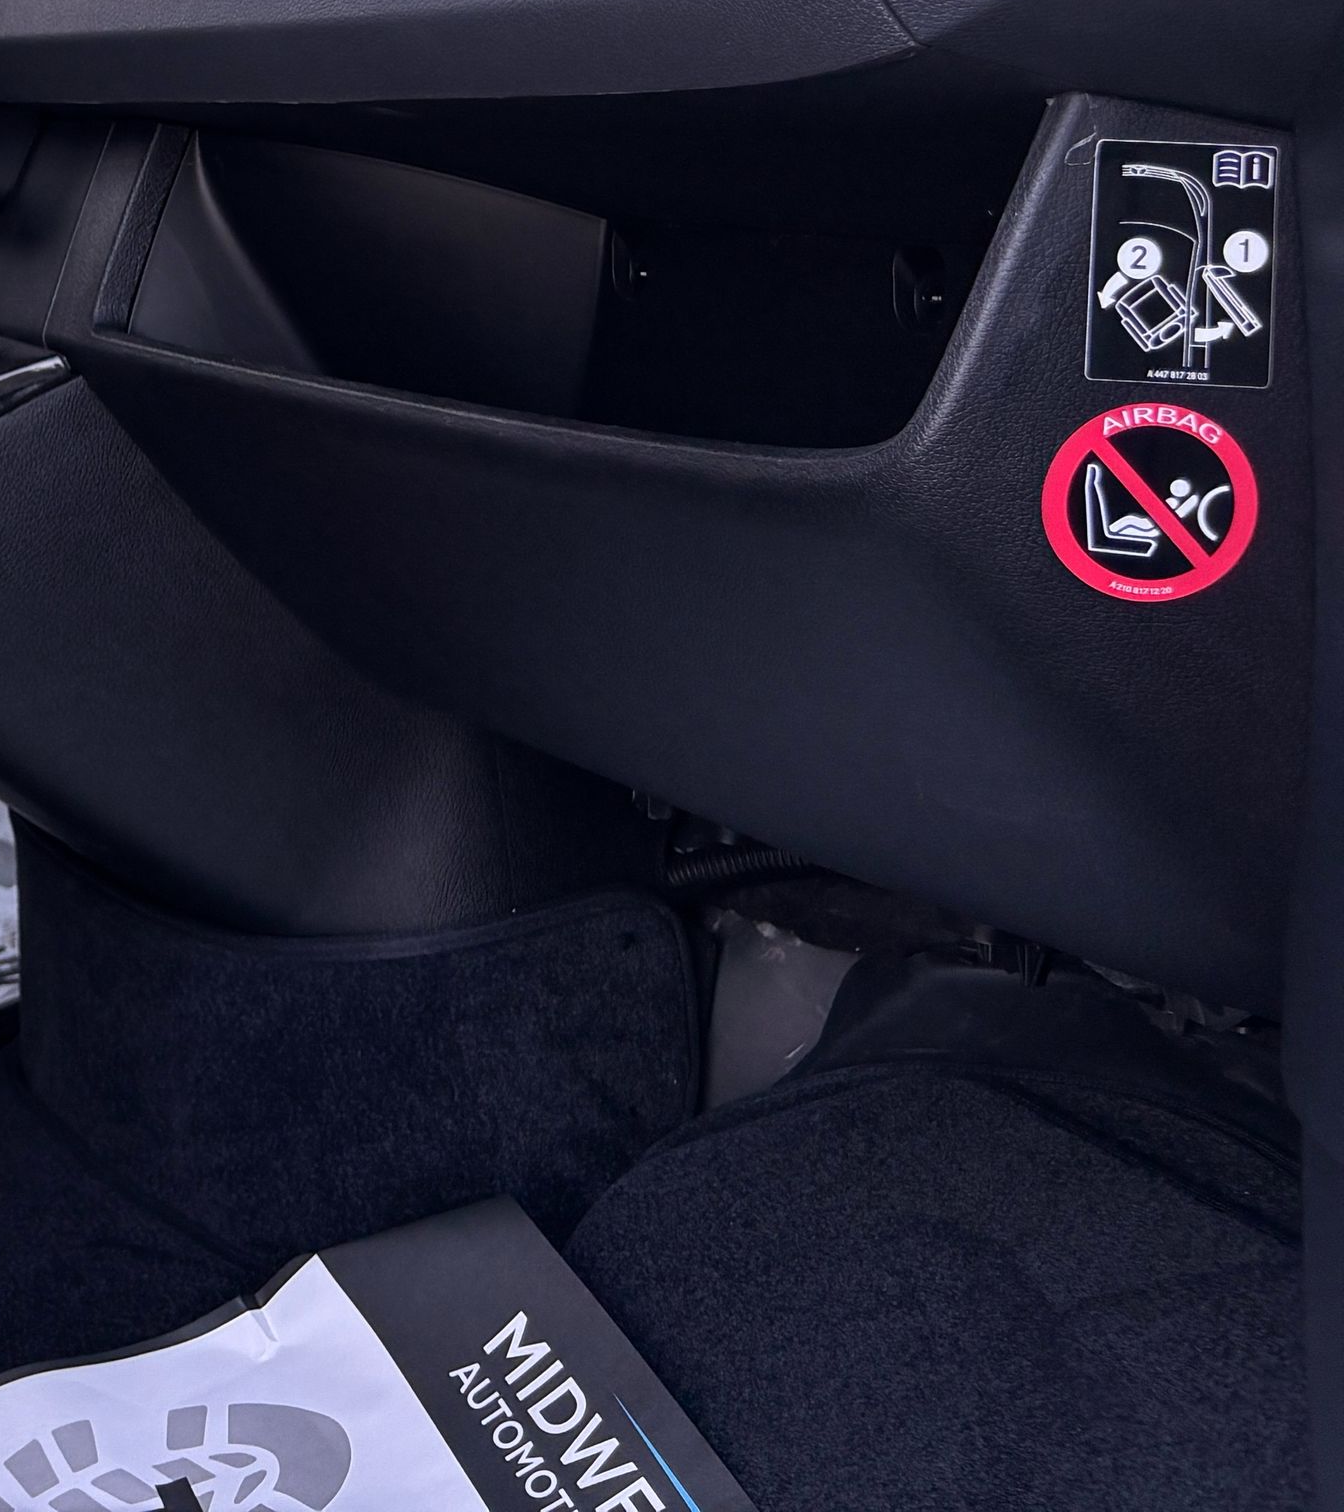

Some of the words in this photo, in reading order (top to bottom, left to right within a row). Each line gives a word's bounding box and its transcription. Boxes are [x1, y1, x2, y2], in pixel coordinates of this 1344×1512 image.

[1129, 244, 1148, 271] 2
[1238, 237, 1251, 265] 1
[1154, 369, 1169, 378] 447
[1170, 371, 1185, 379] 817
[1103, 407, 1222, 444] AIRBAG
[448, 1362, 578, 1512] AUTOMOT
